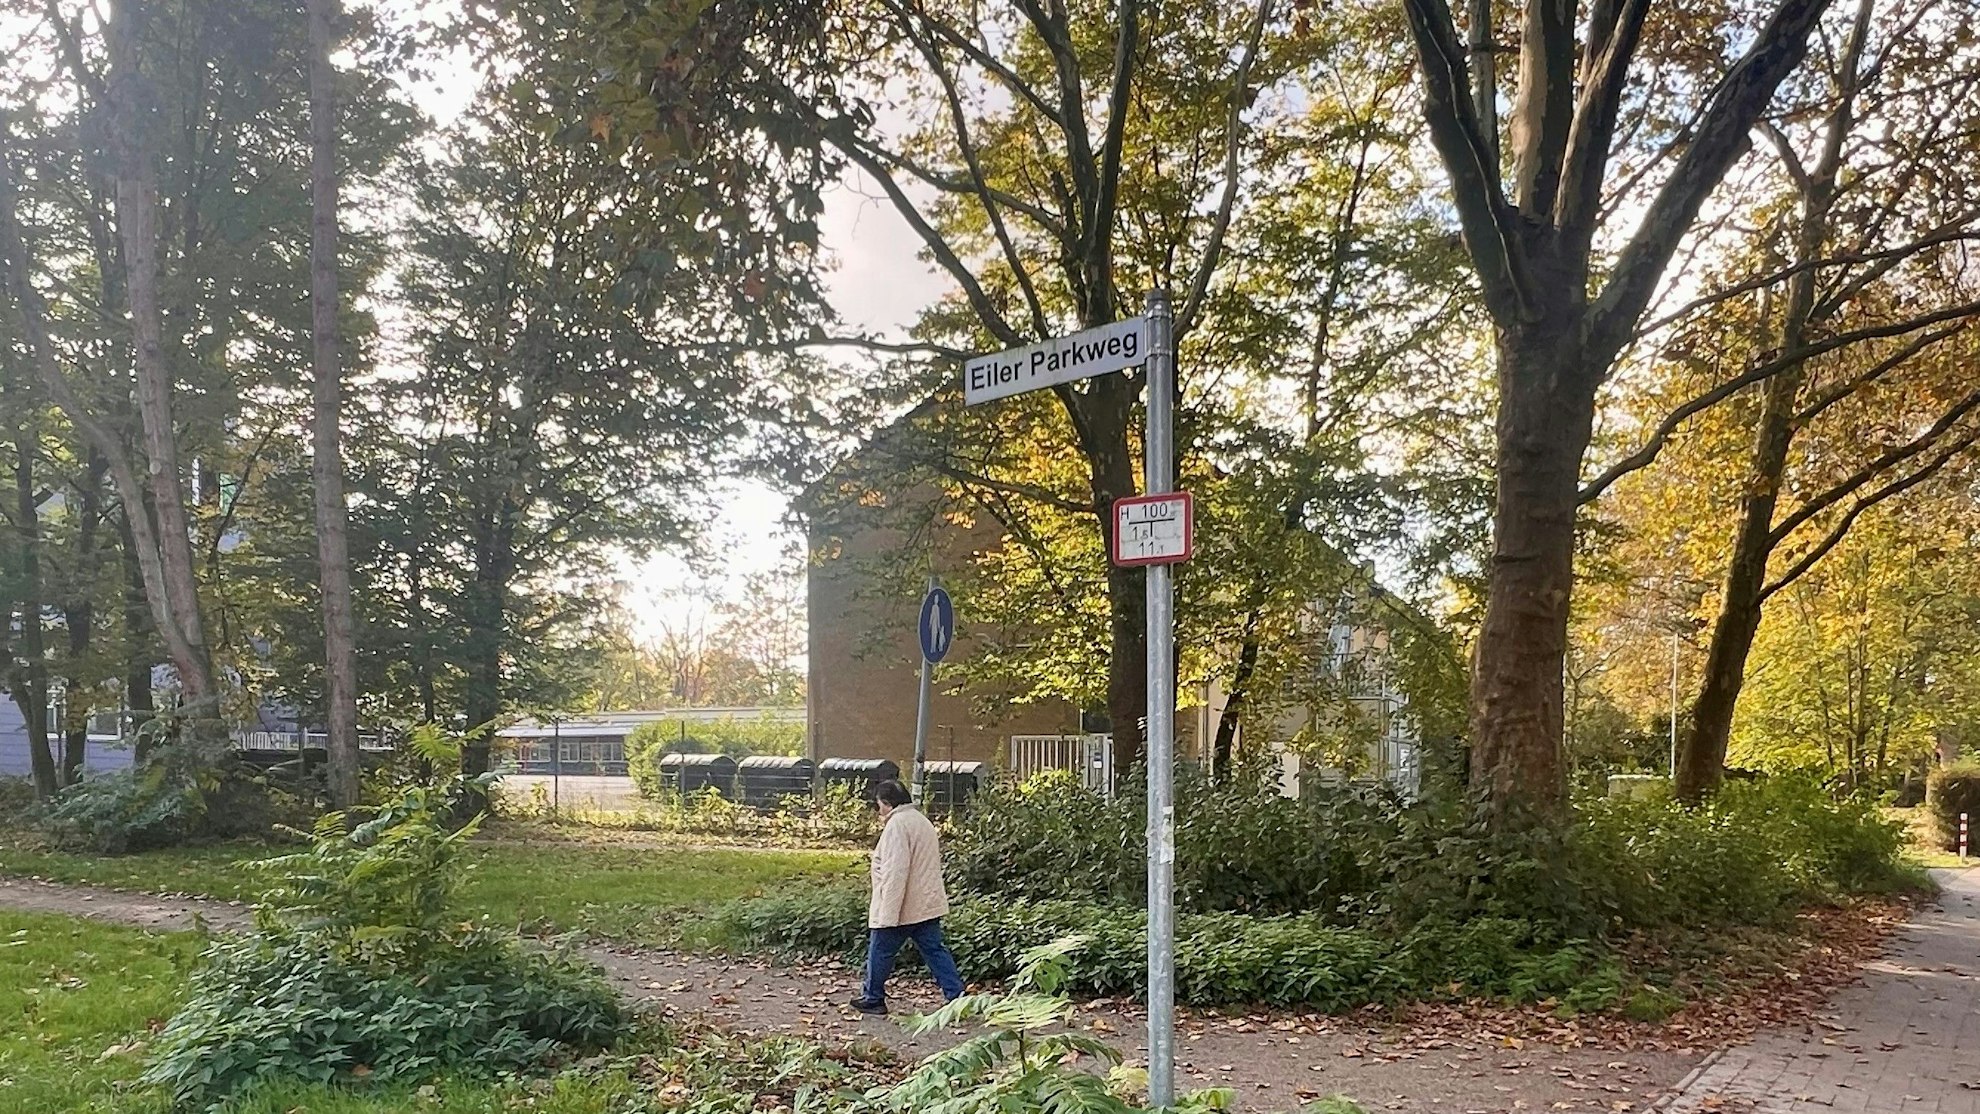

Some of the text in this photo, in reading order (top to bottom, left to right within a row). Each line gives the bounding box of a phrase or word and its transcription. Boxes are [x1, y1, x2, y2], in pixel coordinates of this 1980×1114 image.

[971, 332, 1138, 391] Eiler Parkweg
[1120, 503, 1168, 520] H 100
